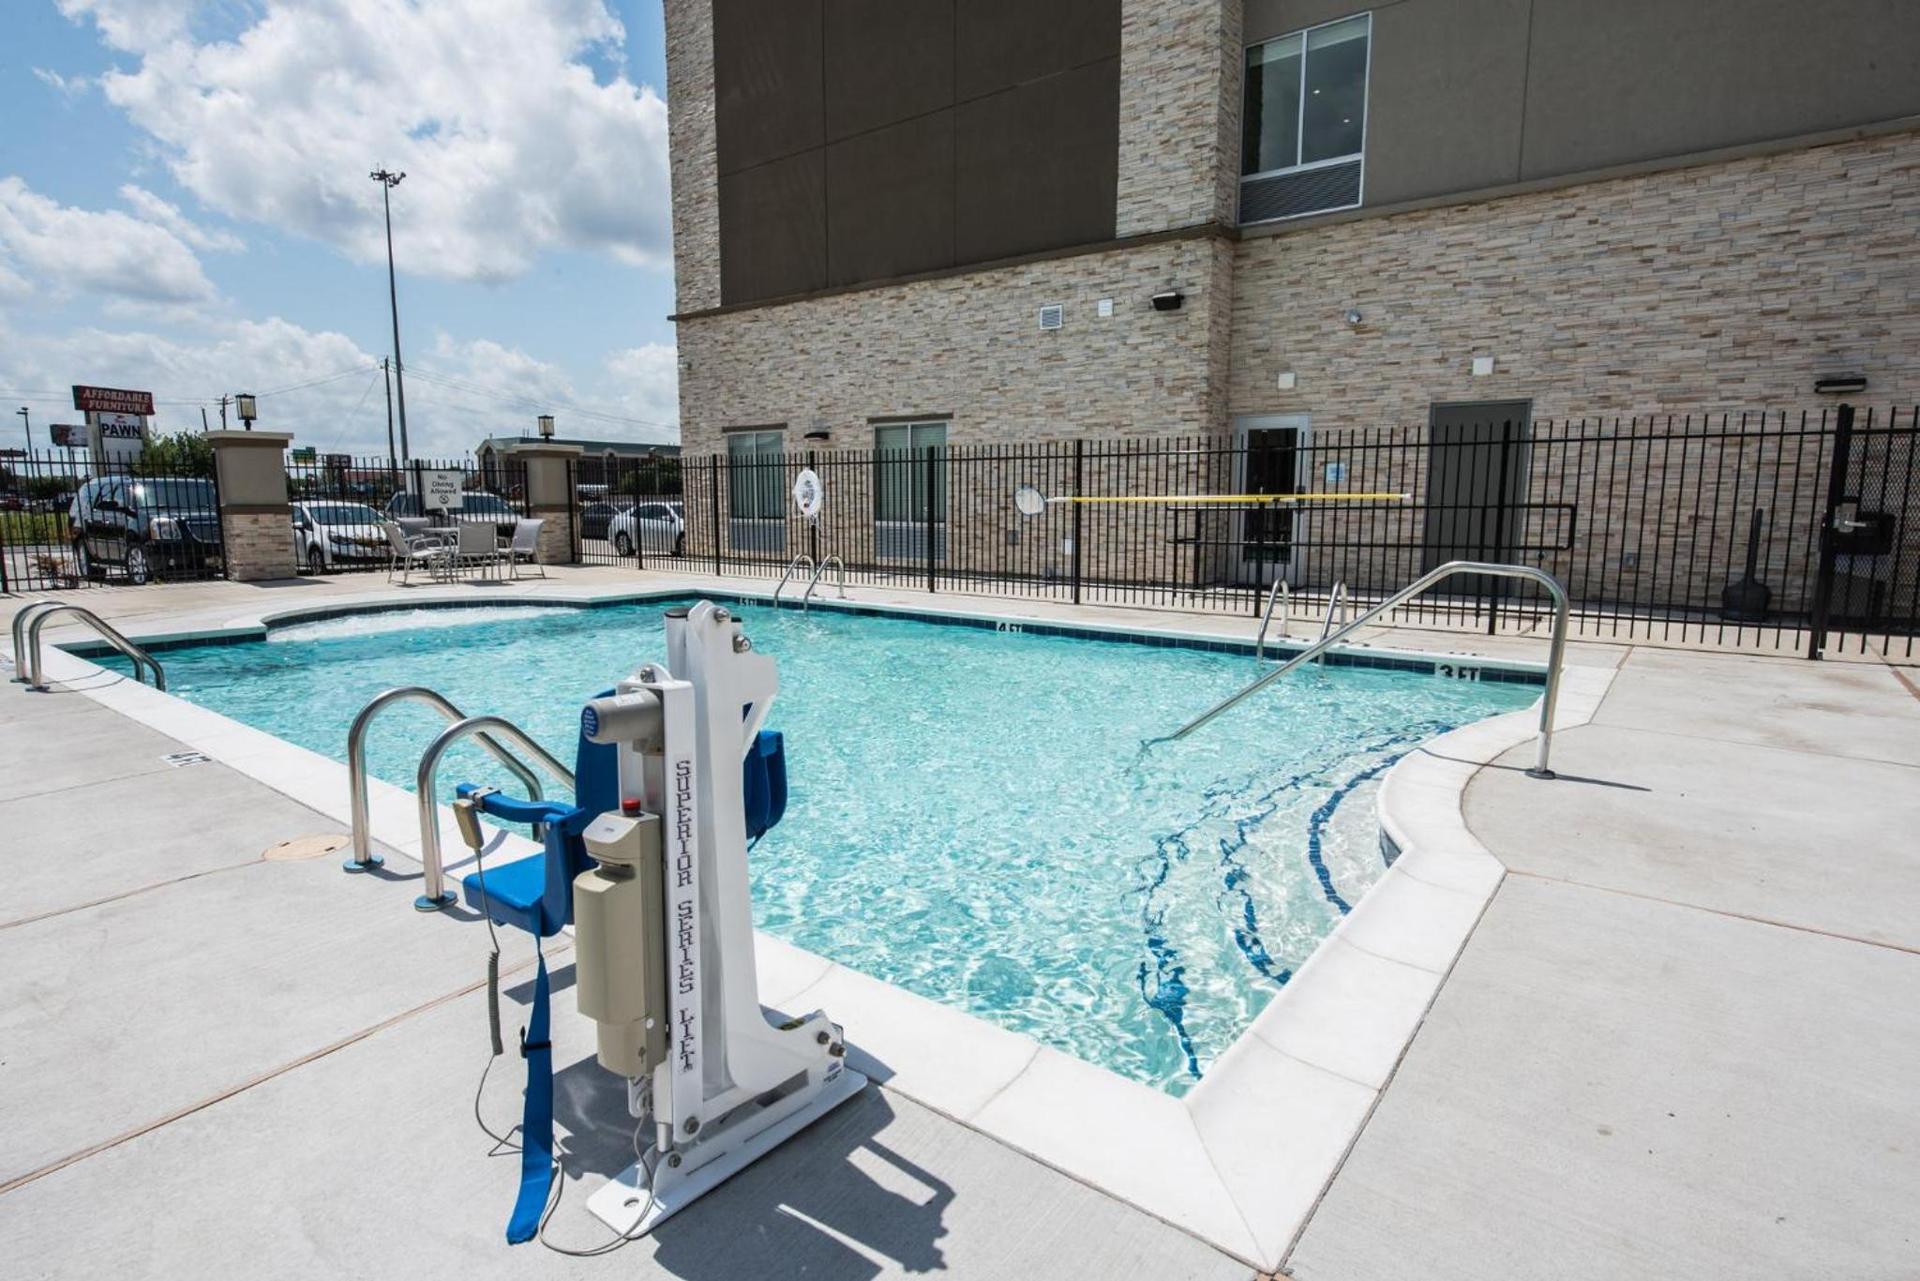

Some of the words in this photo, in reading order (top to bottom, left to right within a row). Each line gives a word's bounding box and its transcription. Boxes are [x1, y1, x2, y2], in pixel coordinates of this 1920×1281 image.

[83, 389, 150, 403] AFFORDABLE
[89, 399, 148, 412] FURNITURE
[101, 423, 140, 437] PAWN
[999, 623, 1006, 632] 4
[1440, 664, 1453, 677] 3
[1458, 667, 1479, 681] FT
[676, 760, 692, 888] SUPERIOR
[677, 900, 693, 995] SERIES
[680, 1006, 695, 1074] LIFT
